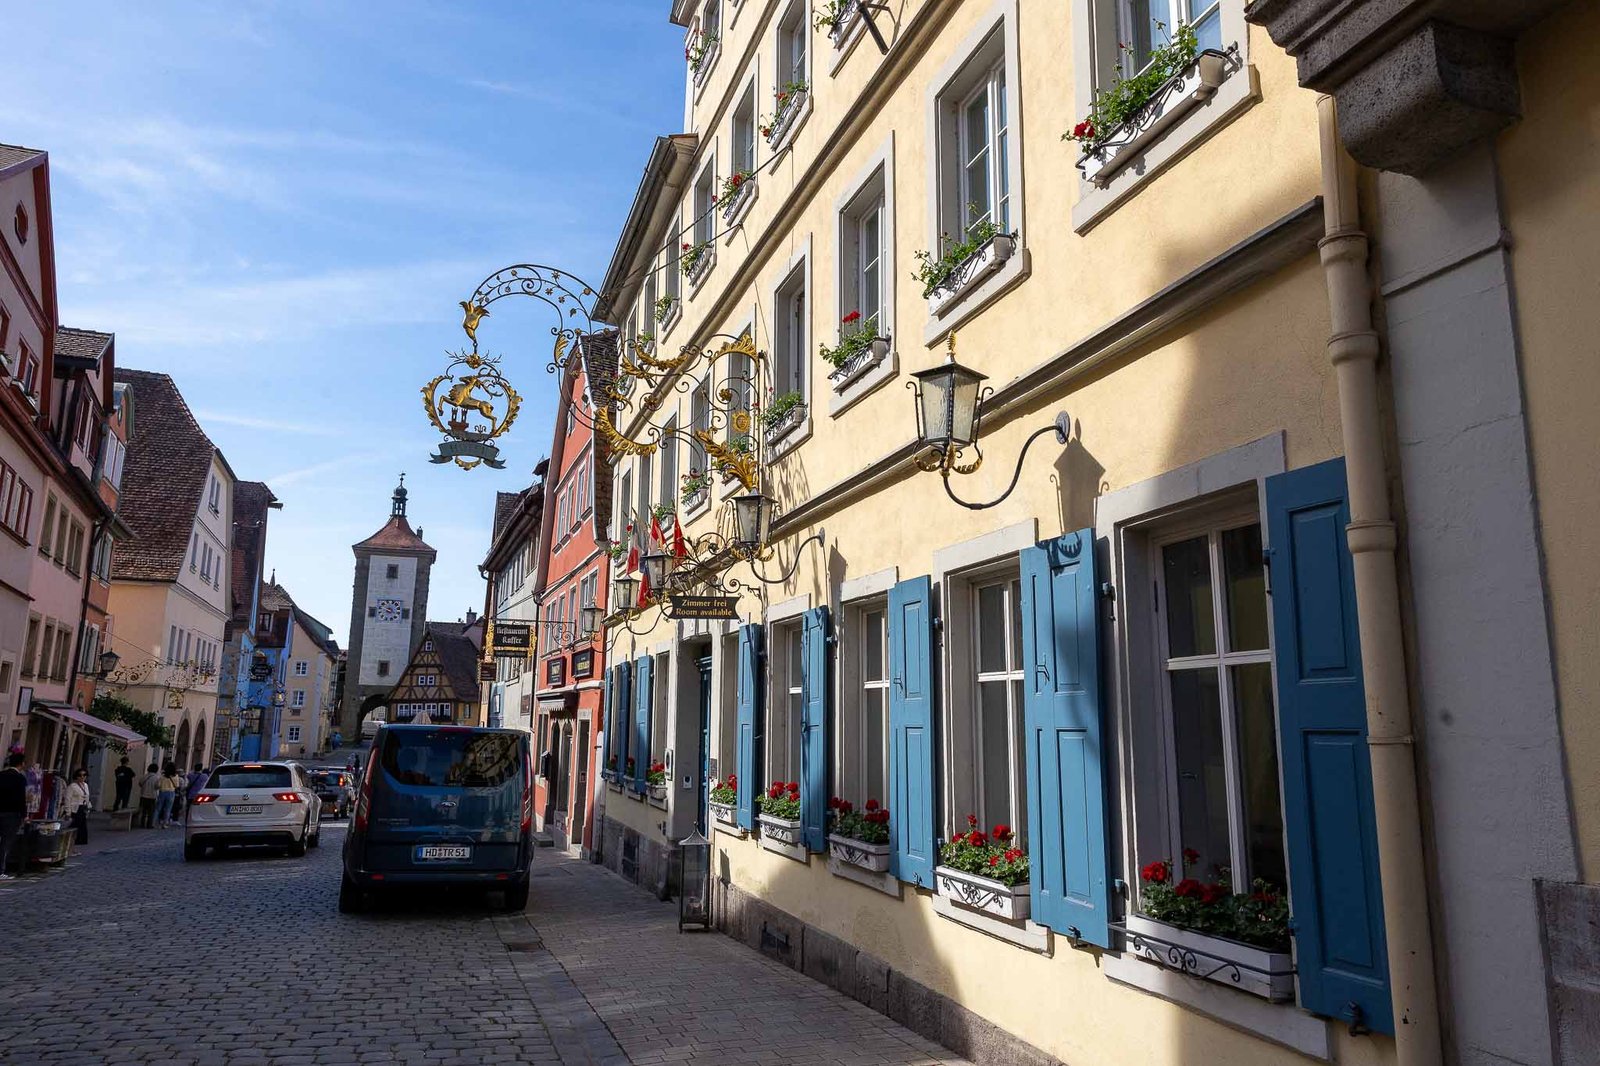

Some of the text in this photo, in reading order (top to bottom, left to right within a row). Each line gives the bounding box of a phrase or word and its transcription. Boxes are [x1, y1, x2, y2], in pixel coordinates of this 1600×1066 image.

[681, 599, 711, 607] Zimmer
[676, 608, 732, 616] Room available
